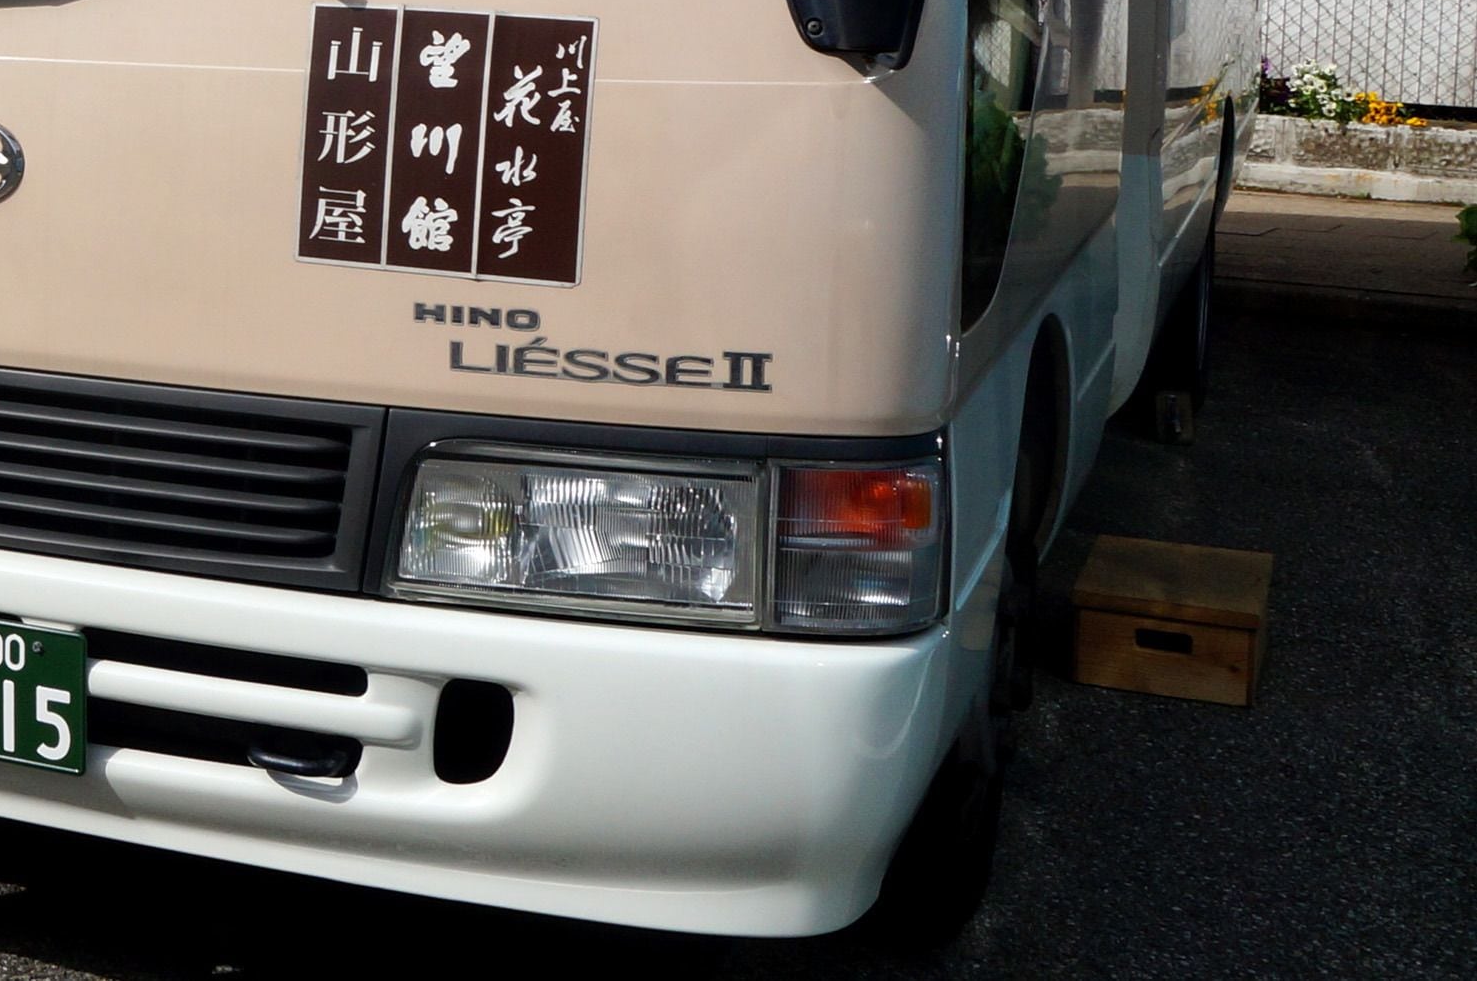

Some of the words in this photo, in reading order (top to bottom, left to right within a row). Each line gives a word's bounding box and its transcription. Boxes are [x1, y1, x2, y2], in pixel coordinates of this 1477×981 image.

[308, 25, 383, 246] 山形屋
[400, 30, 472, 253] 望川館
[491, 64, 543, 259] 花水亭
[547, 34, 588, 134] 川上屋
[413, 302, 541, 331] HINO
